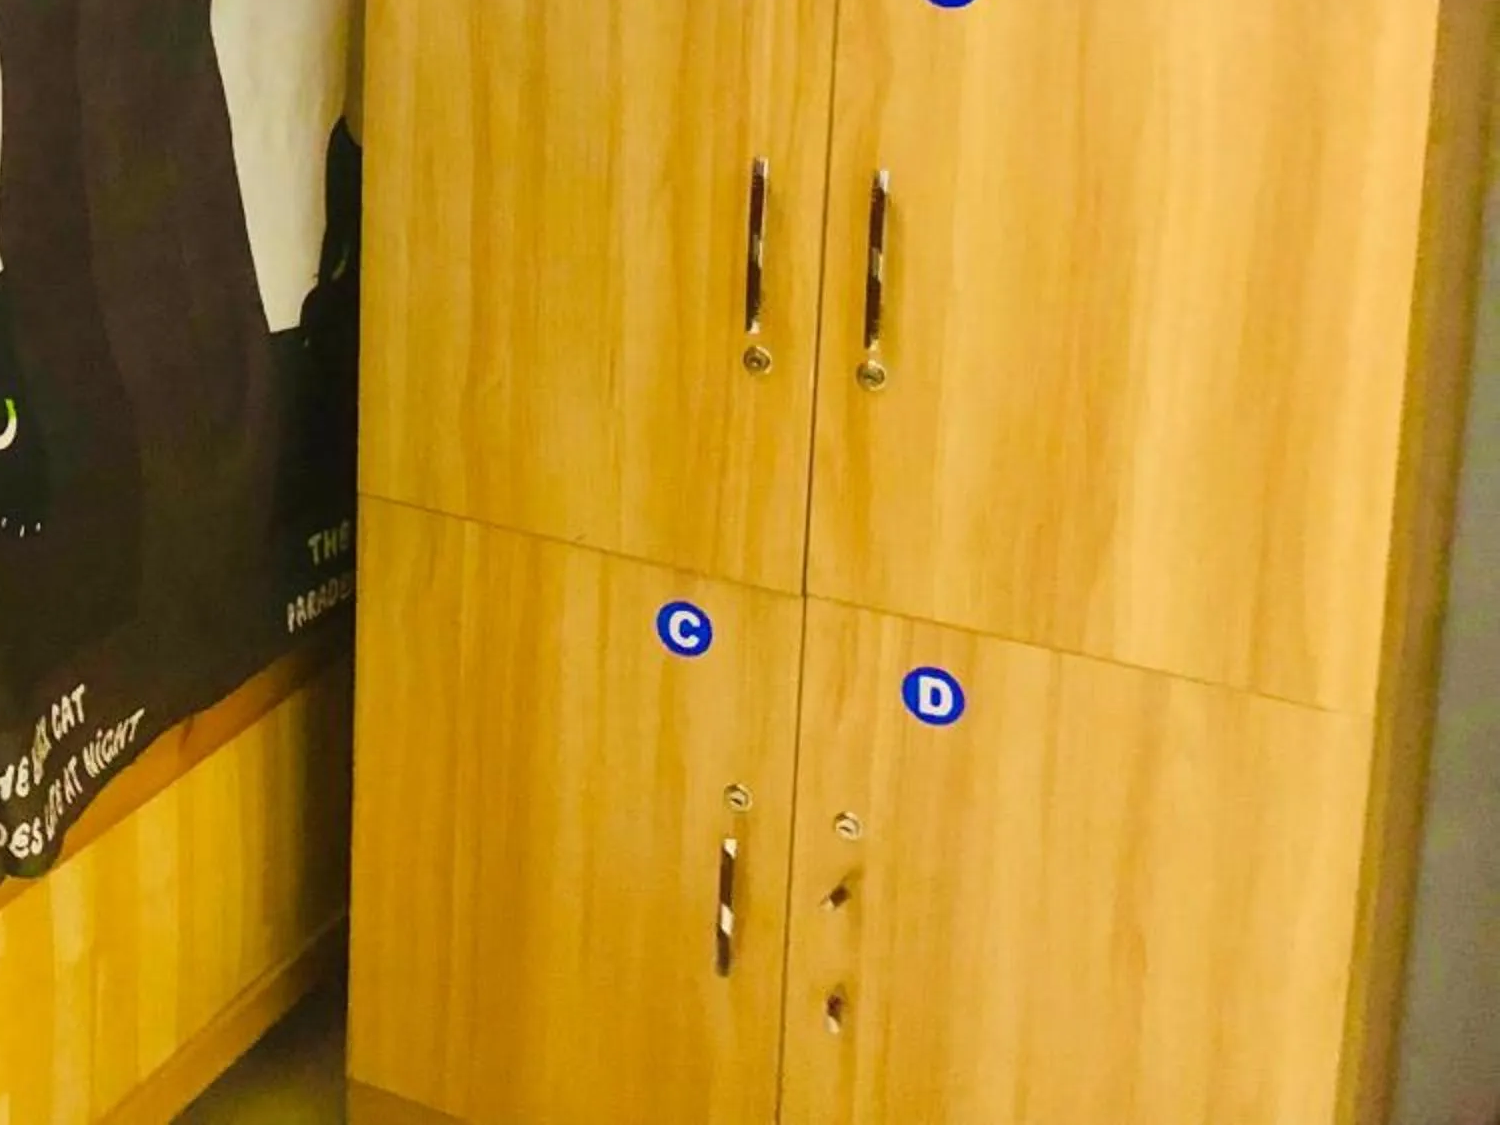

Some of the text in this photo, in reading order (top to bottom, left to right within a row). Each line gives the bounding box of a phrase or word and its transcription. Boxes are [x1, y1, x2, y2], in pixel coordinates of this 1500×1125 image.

[669, 610, 701, 648] C
[51, 683, 85, 742] CAT
[919, 676, 953, 716] D
